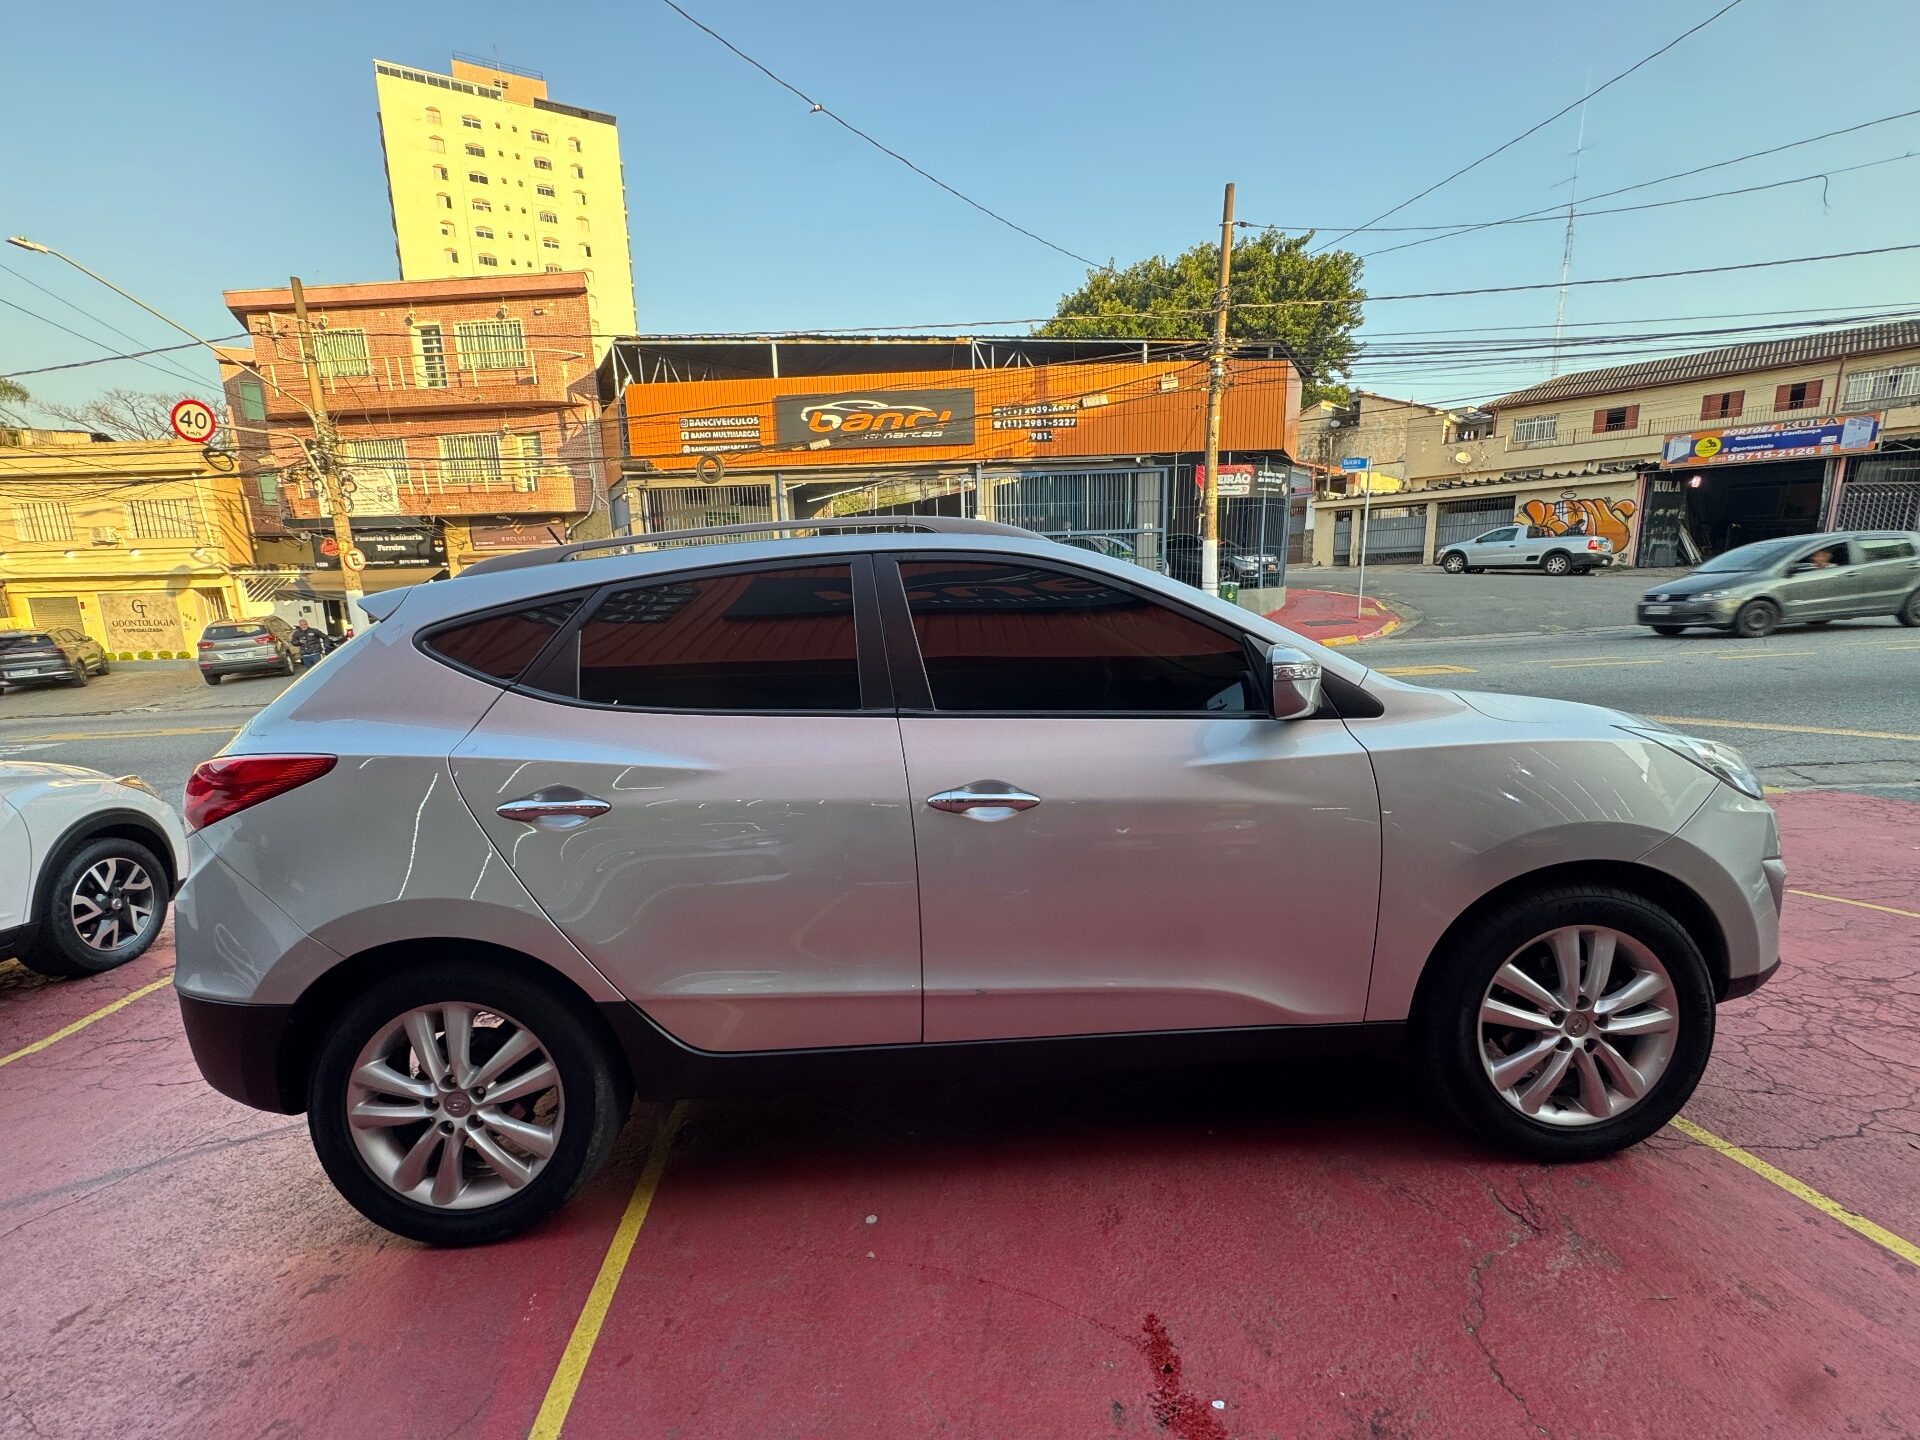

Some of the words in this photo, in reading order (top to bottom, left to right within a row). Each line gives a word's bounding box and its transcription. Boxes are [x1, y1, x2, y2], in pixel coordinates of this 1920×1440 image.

[179, 410, 207, 429] 40
[688, 416, 759, 427] BANCIVEICULOS
[1002, 419, 1022, 429] (11)
[1024, 418, 1076, 427] 2981-5227
[1782, 418, 1839, 431] KULA
[690, 431, 712, 439] BANCI
[712, 430, 760, 439] MULTIMARCAS
[1728, 447, 1816, 461] 96715-2126
[1217, 472, 1251, 486] EIRÃO
[1653, 480, 1681, 493] KULA
[376, 543, 407, 552] Ferreira
[112, 618, 176, 628] ODONTOLOGIA
